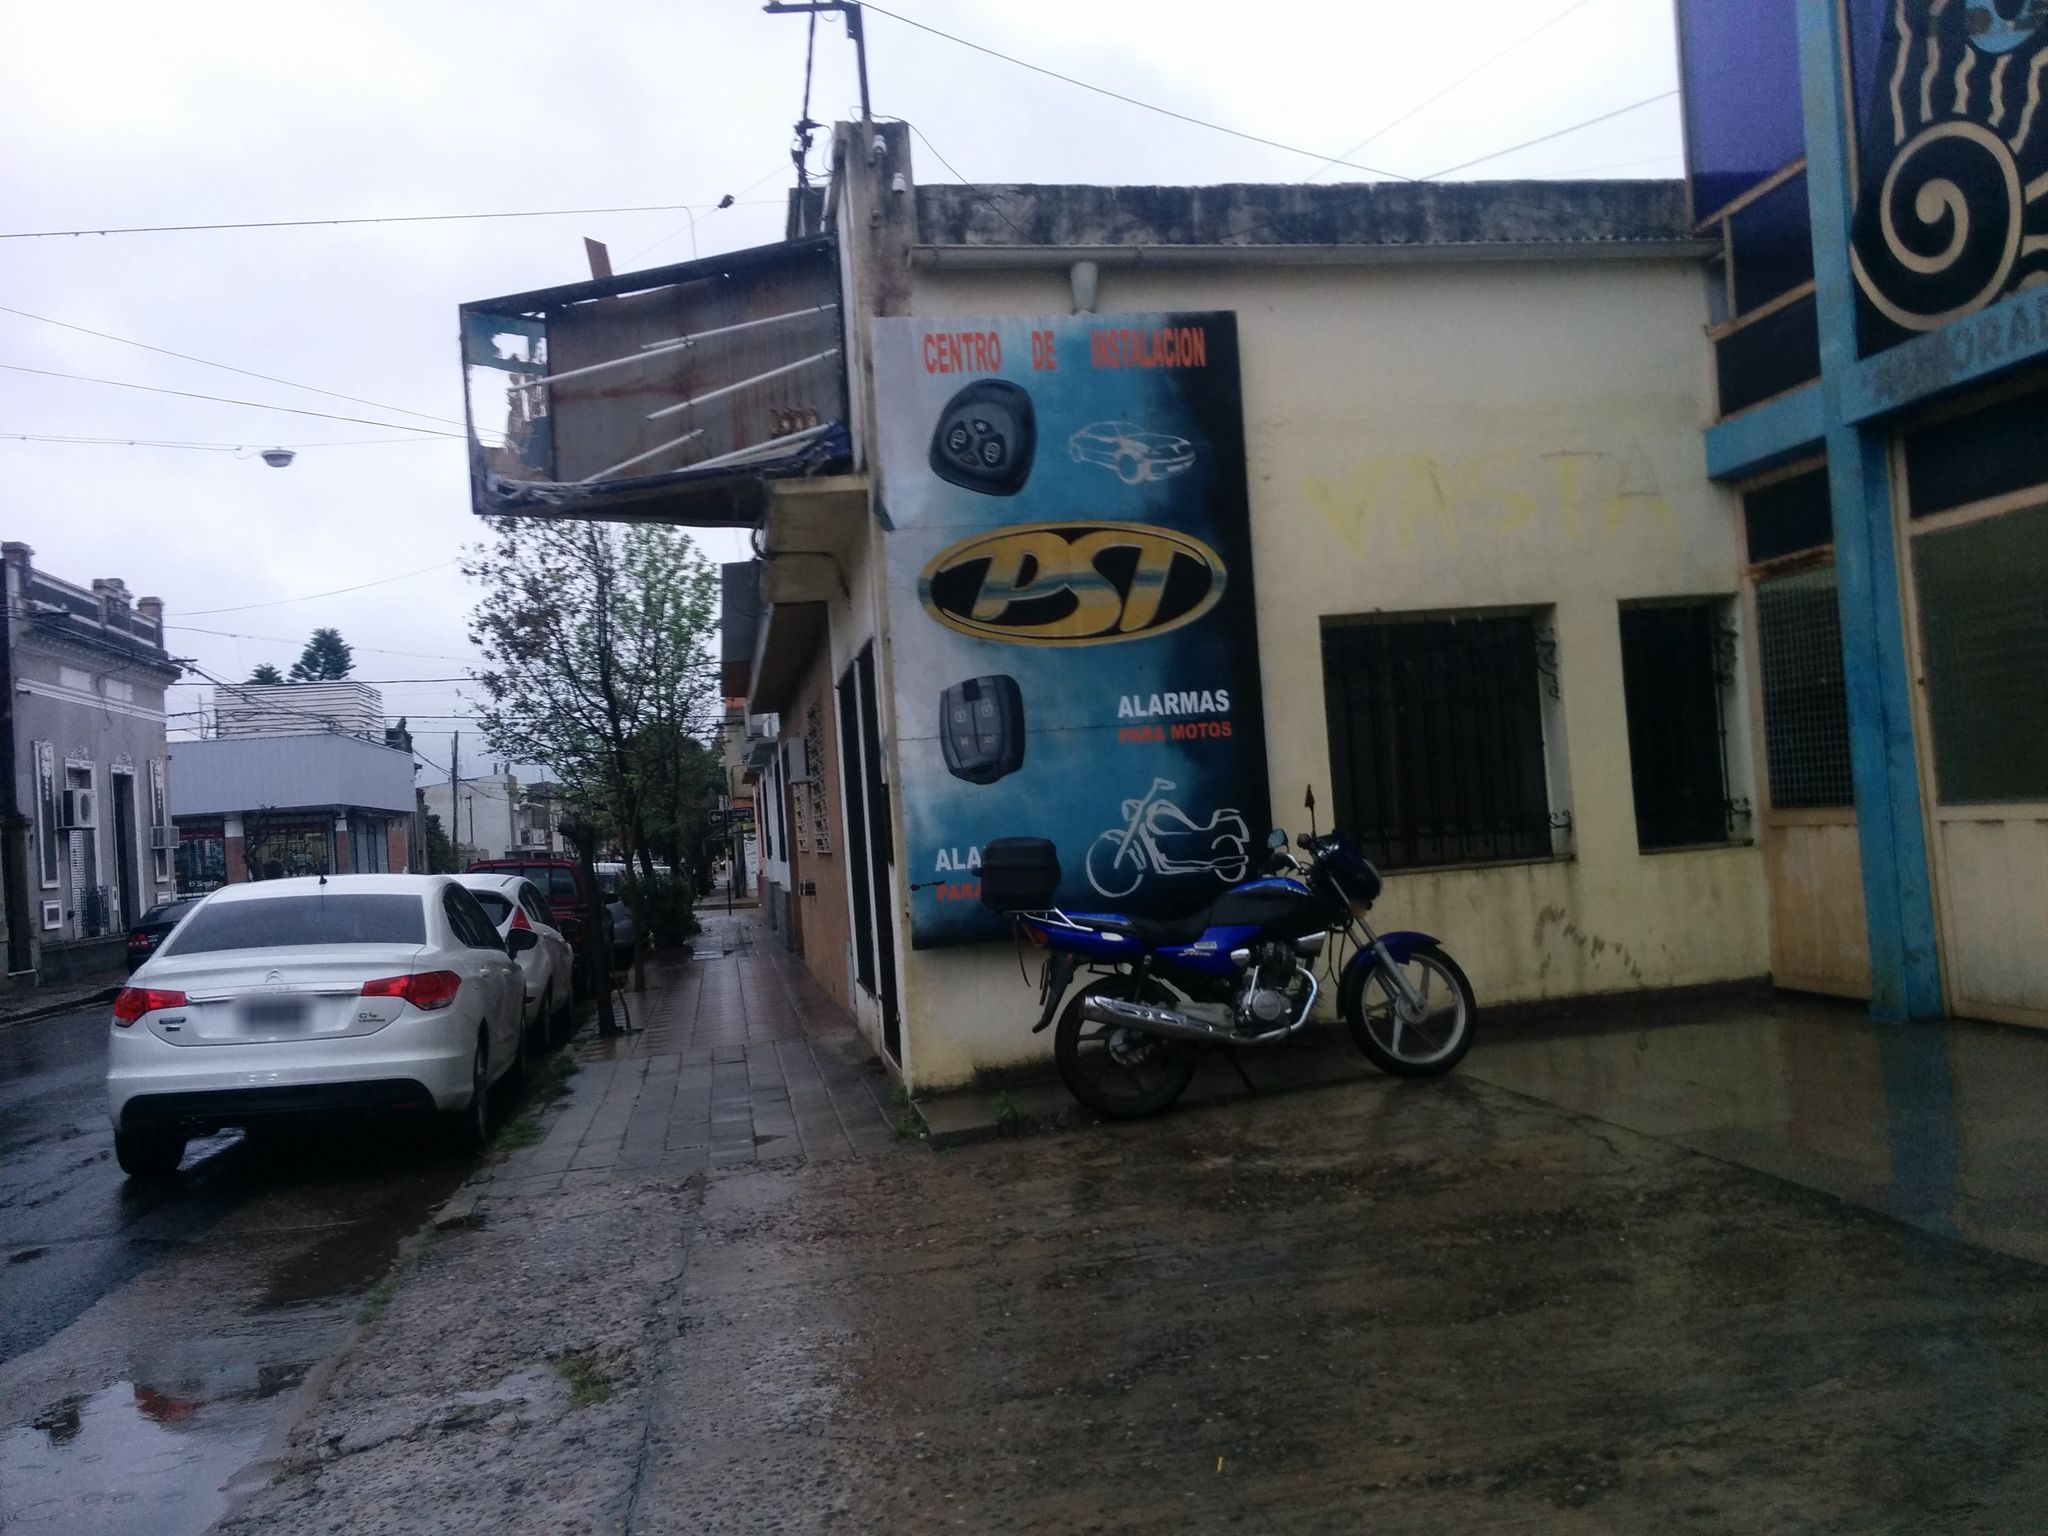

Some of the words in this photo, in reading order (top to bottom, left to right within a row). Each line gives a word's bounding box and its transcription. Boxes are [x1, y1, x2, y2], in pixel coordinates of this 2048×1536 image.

[923, 331, 1001, 374] CENTRO
[1031, 330, 1056, 370] DE
[1117, 689, 1230, 718] ALARMAS
[1170, 721, 1232, 740] MOTOS
[935, 846, 984, 872] ALA
